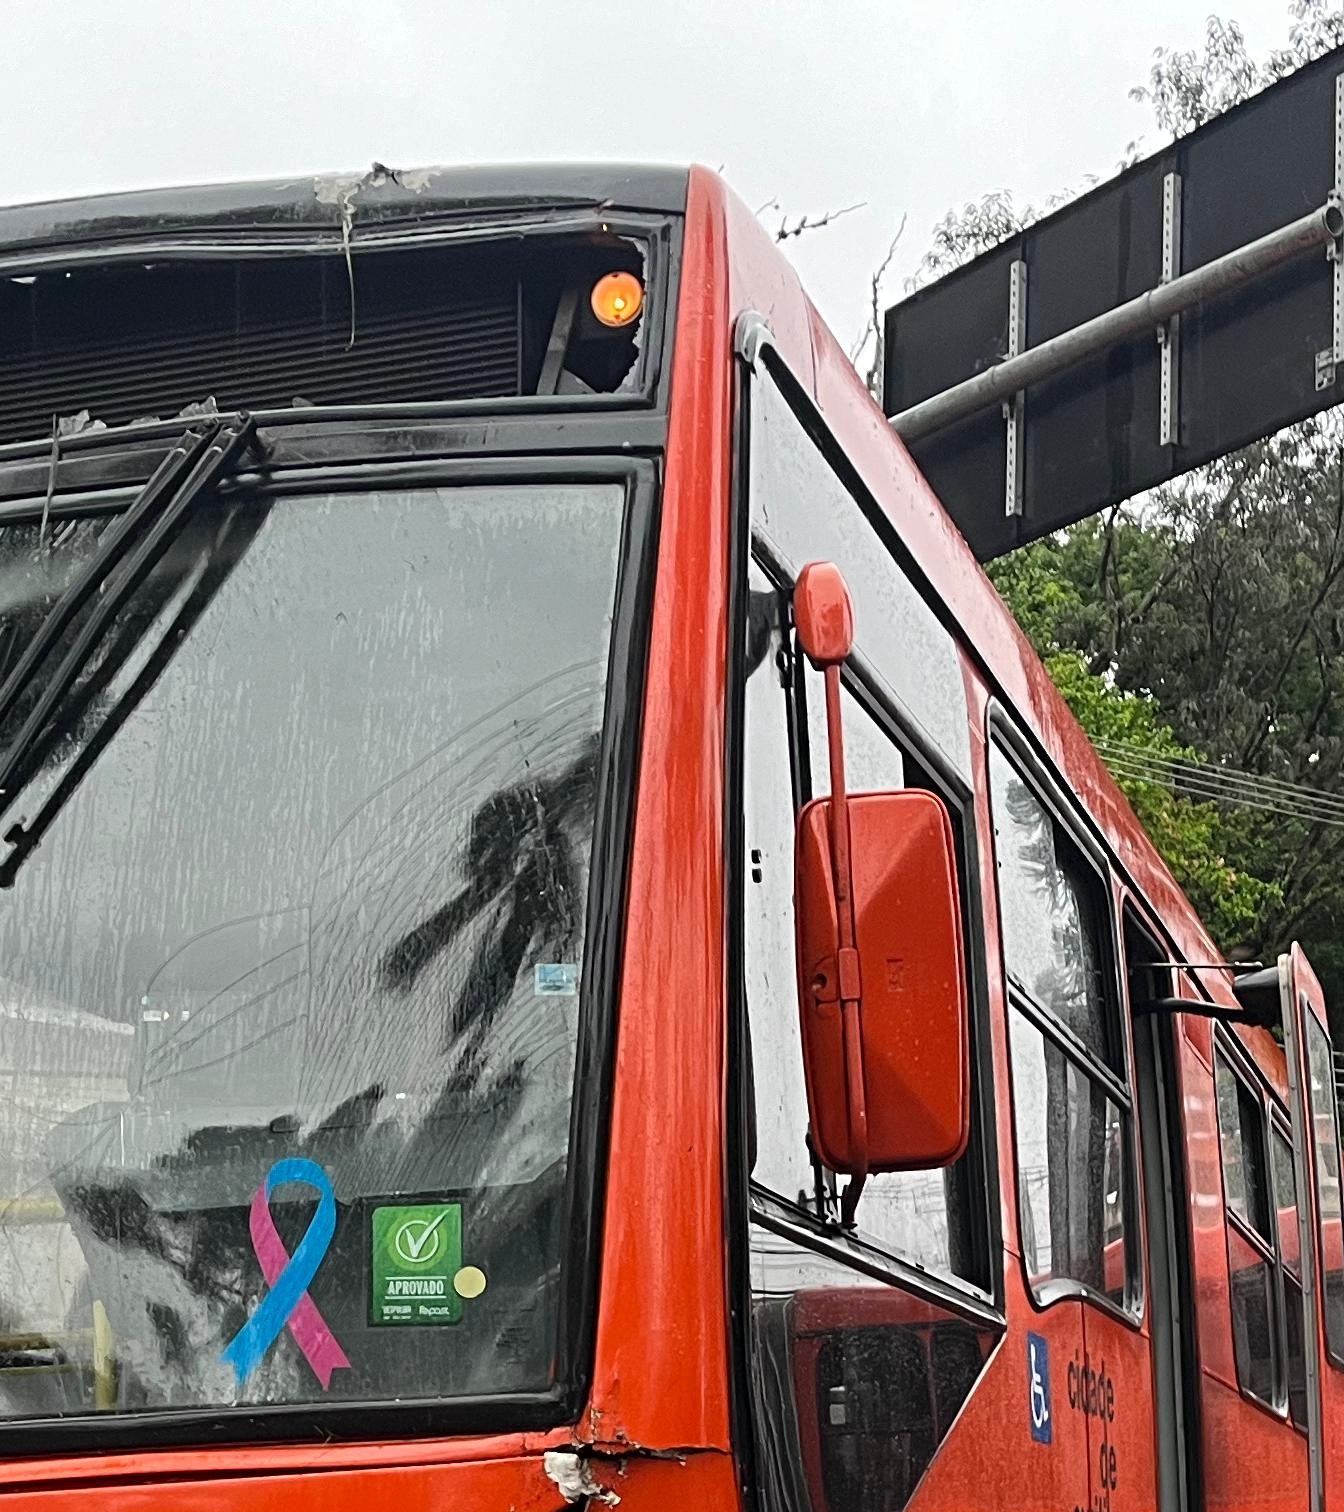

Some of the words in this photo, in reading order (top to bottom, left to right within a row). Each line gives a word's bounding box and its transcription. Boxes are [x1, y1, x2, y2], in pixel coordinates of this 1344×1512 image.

[387, 1280, 444, 1295] APROVADO
[1067, 1348, 1115, 1423] cidade
[1099, 1441, 1116, 1490] de
